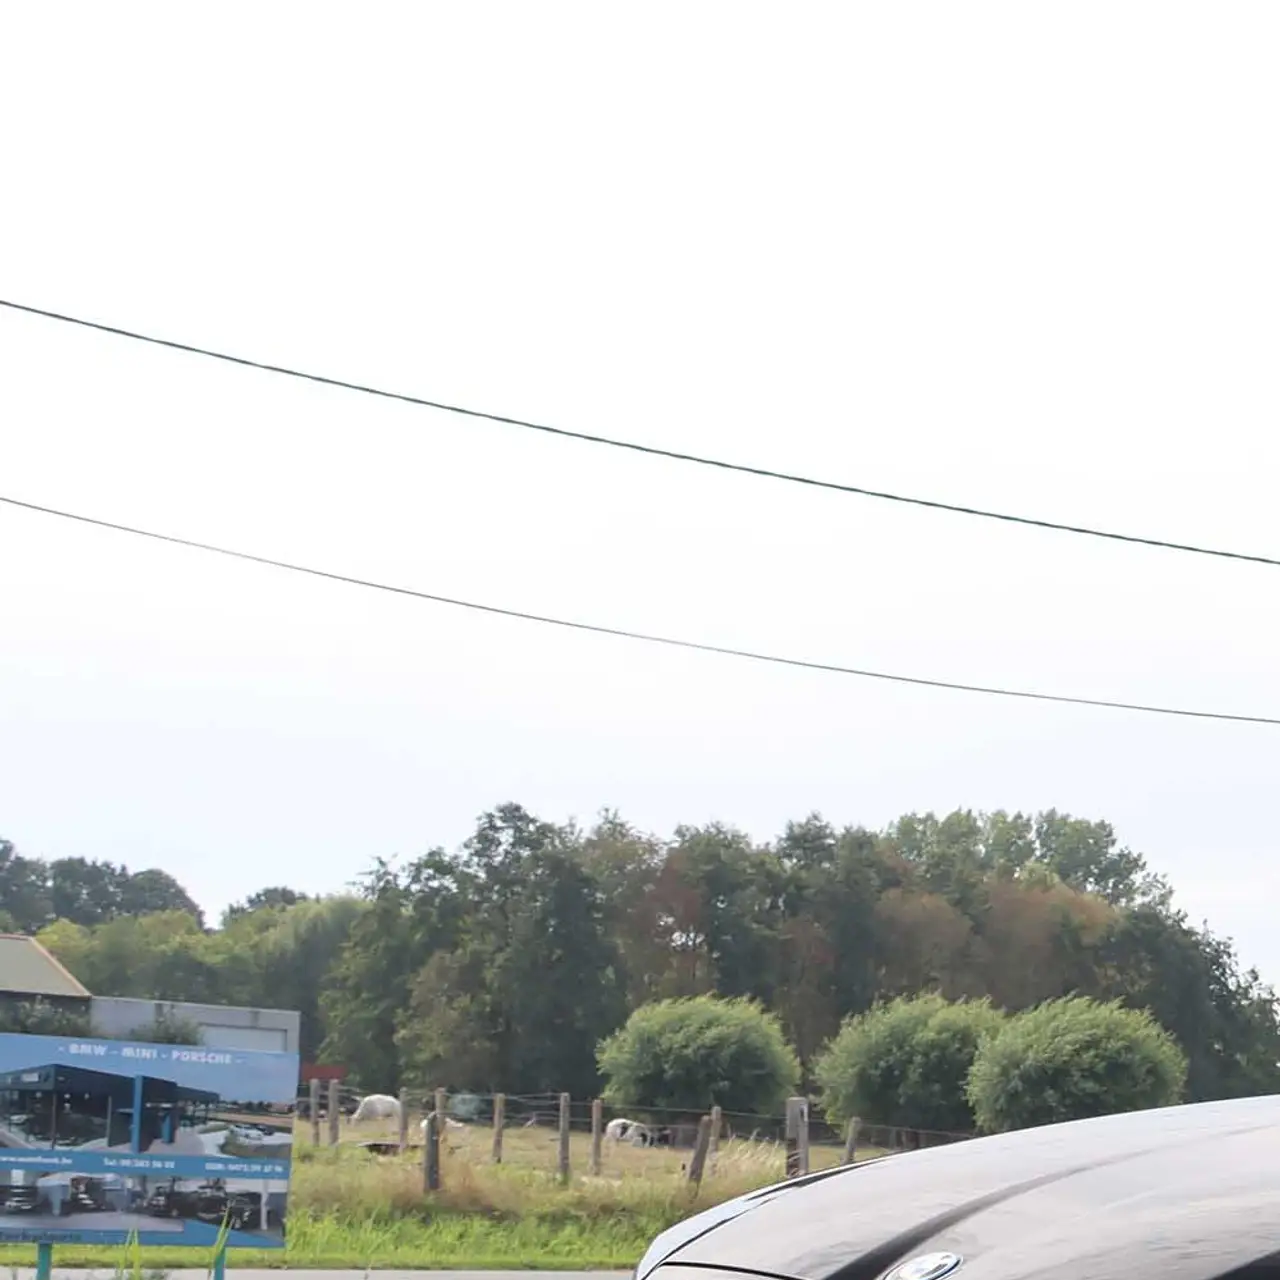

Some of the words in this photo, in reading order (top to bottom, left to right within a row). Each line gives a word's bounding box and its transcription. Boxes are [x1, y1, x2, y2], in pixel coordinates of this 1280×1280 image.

[68, 1043, 109, 1057] BMW
[121, 1046, 158, 1060] MINI
[171, 1050, 233, 1065] PORSCHE
